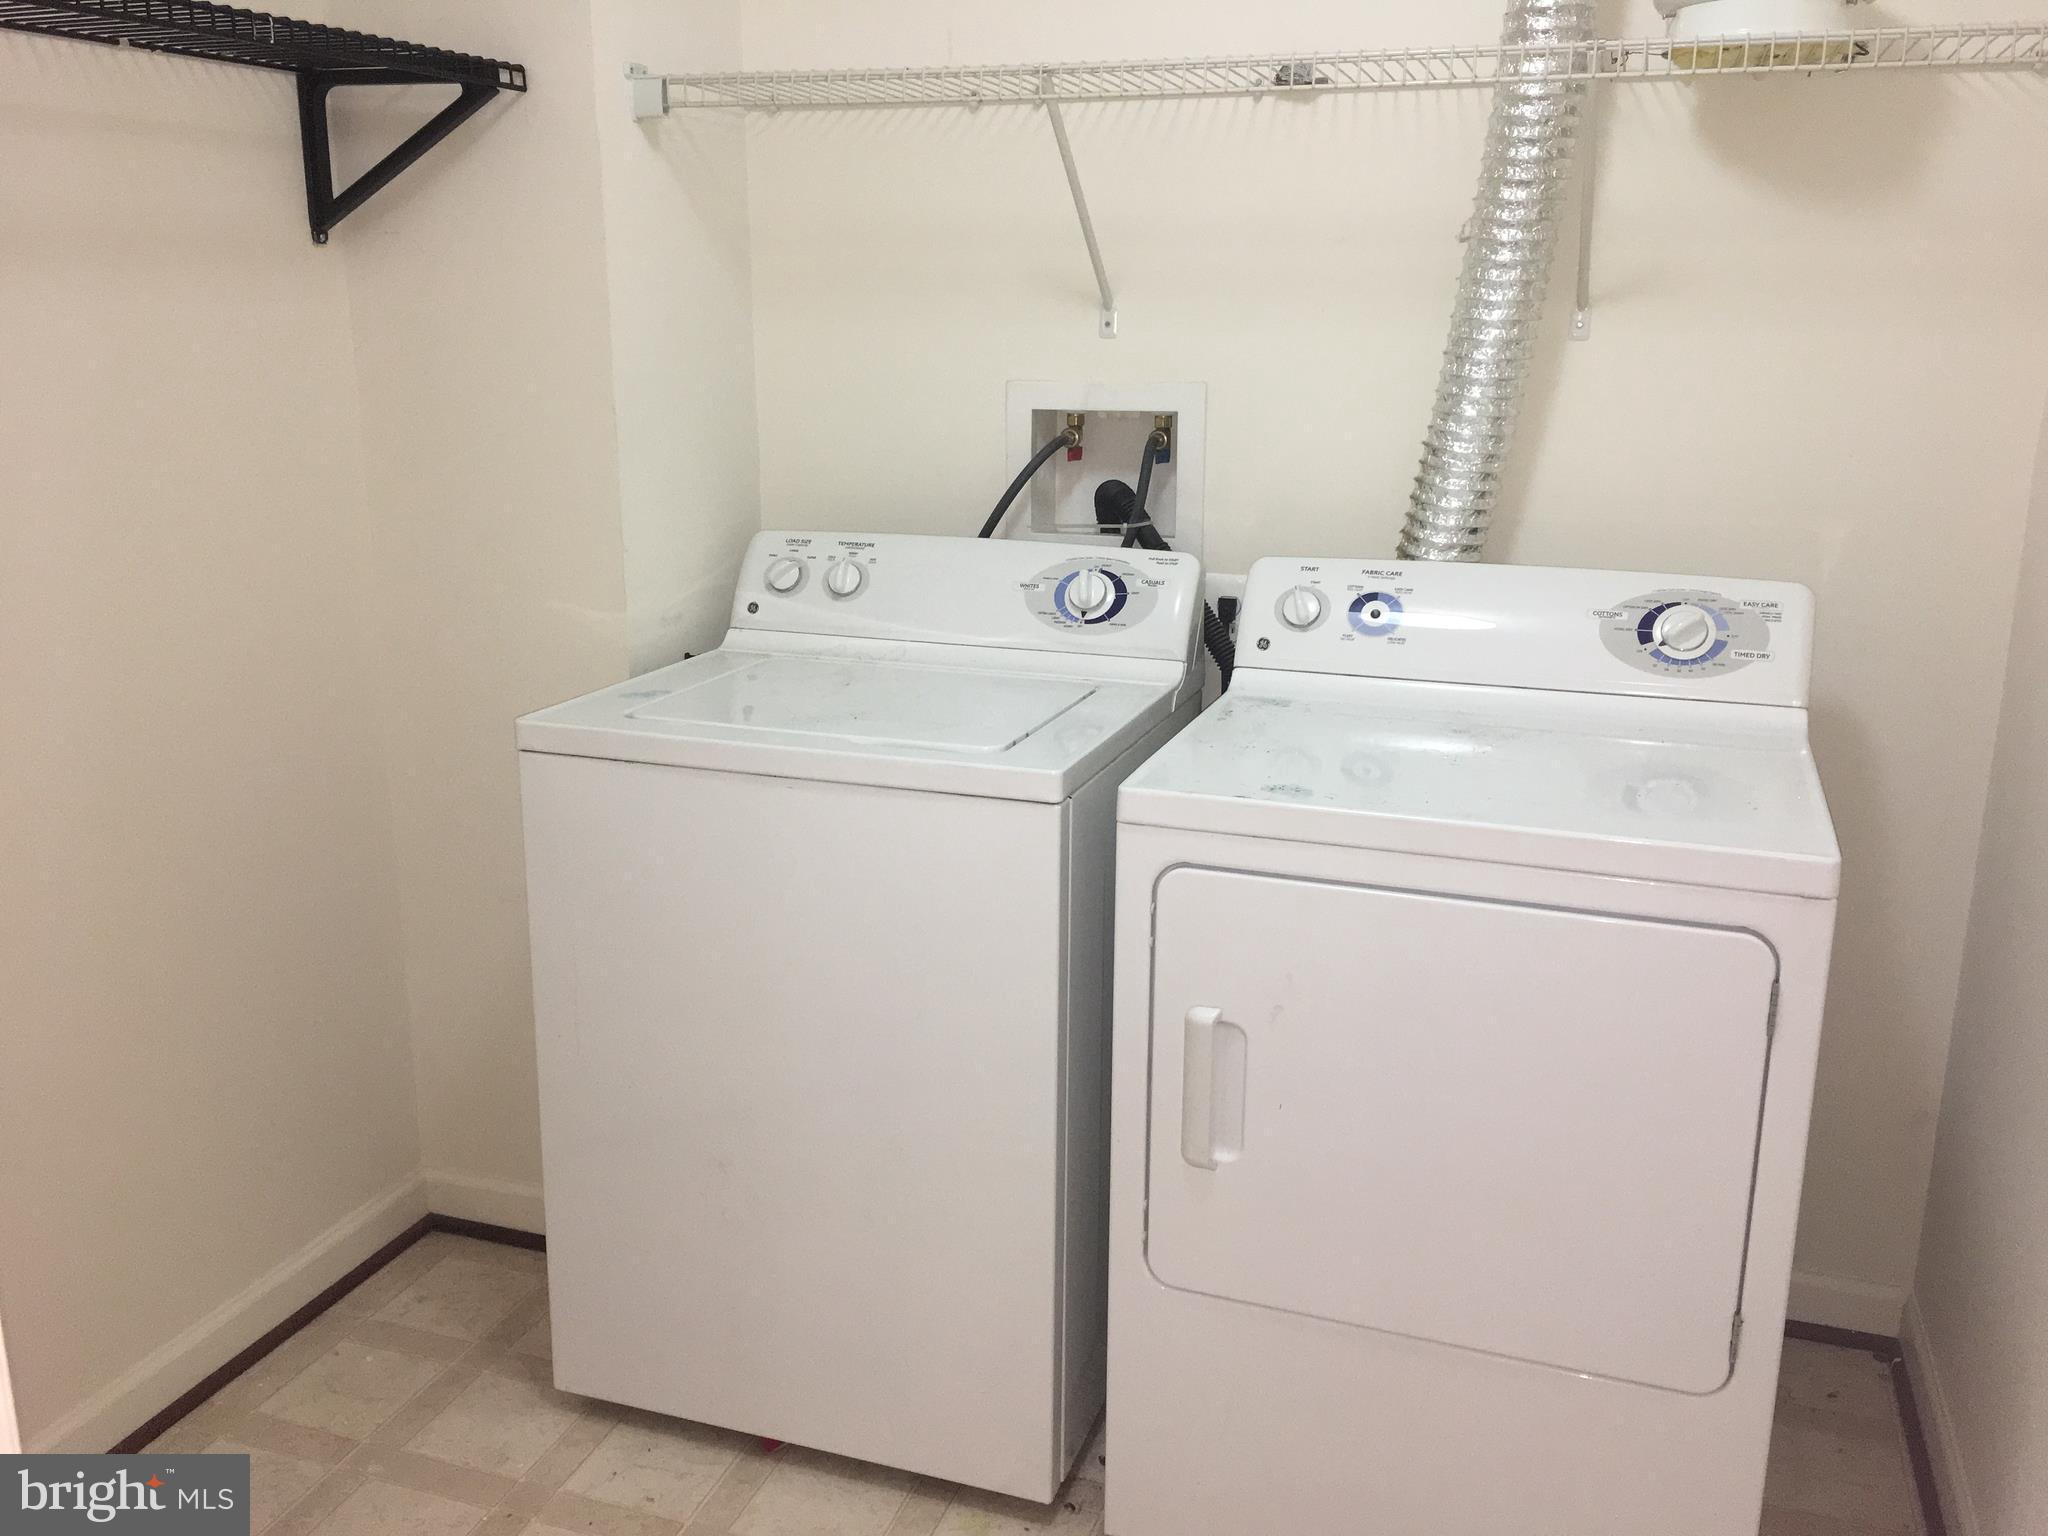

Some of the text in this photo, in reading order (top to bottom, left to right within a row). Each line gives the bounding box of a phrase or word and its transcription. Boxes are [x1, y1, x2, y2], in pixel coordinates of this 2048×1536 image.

[1592, 610, 1623, 618] COTTONS
[1734, 651, 1771, 660] TIMED DRY
